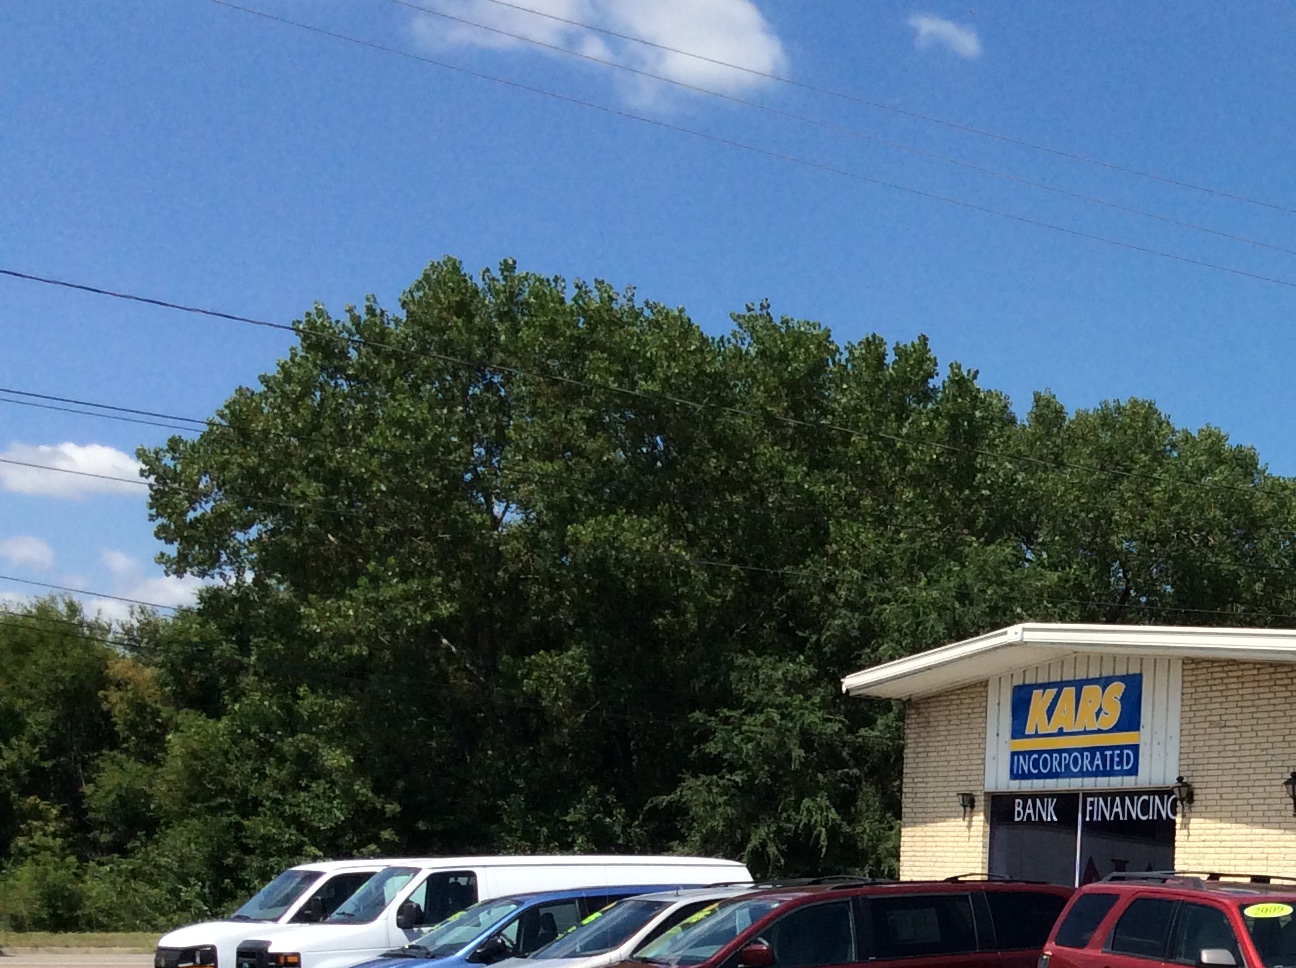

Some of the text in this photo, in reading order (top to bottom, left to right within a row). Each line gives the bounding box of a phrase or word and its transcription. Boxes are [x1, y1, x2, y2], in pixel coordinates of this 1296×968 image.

[1025, 681, 1126, 735] KARS
[1013, 749, 1134, 775] INCORPORATED
[1014, 797, 1058, 822] BANK
[1253, 905, 1285, 916] 2009
